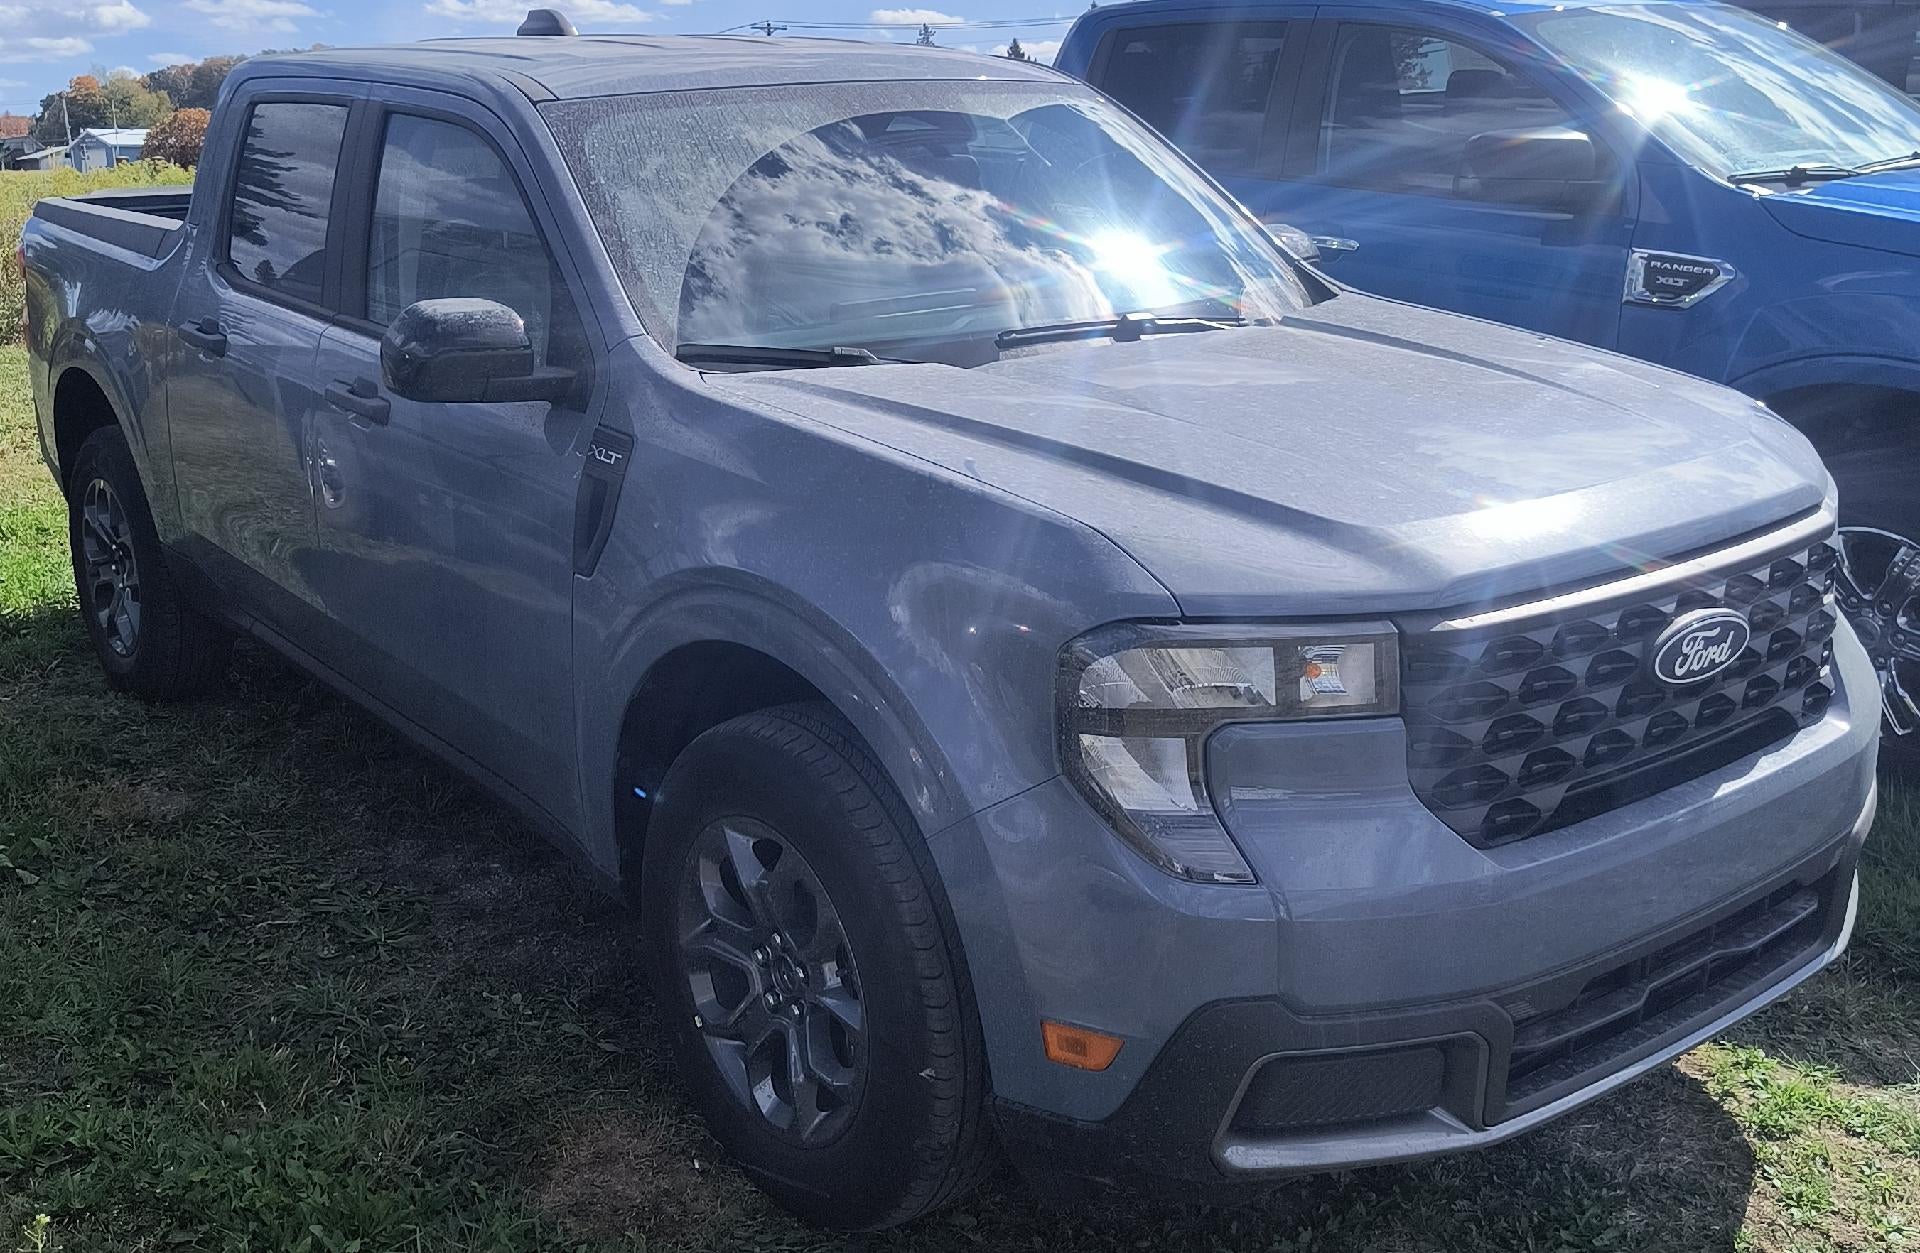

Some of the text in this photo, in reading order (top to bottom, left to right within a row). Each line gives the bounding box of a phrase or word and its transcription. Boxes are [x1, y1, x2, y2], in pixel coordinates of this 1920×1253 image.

[1650, 260, 1714, 275] RANGER
[1655, 275, 1689, 287] XLT
[587, 444, 623, 465] XLT
[1674, 626, 1735, 677] Ford
